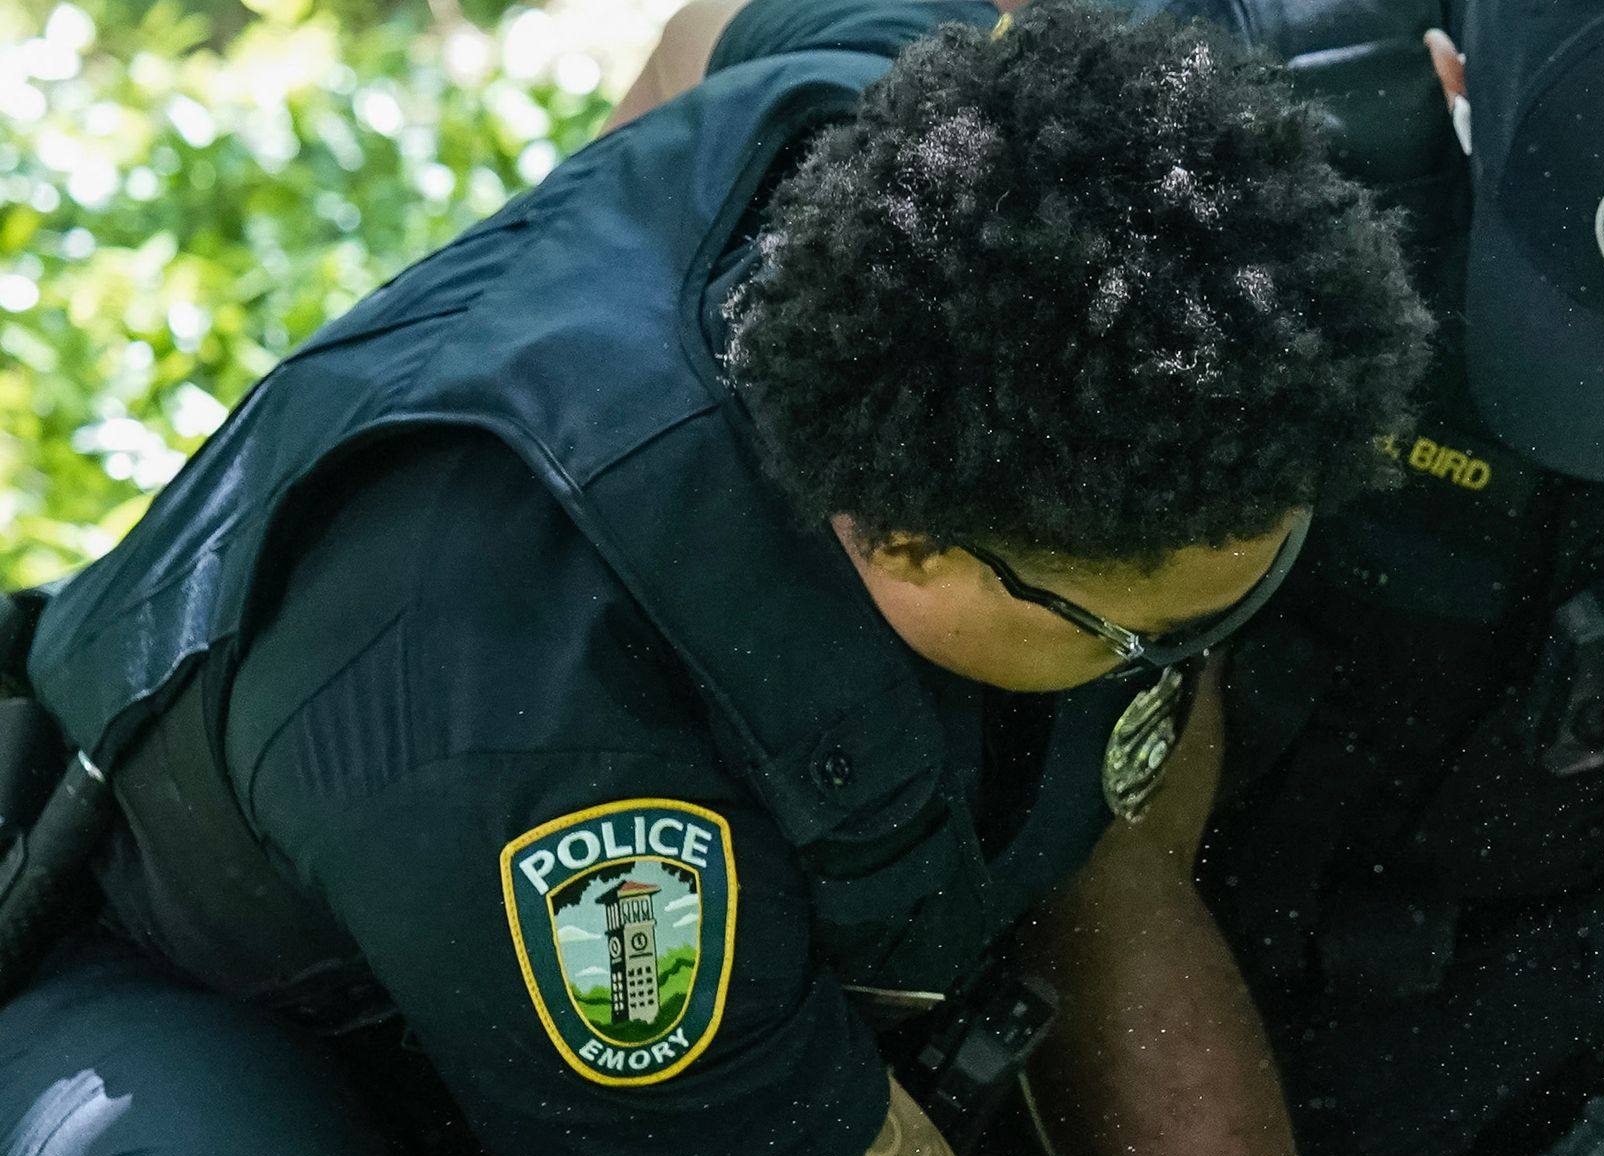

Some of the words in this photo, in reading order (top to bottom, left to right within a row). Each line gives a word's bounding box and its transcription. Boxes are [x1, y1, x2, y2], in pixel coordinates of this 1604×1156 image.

[1409, 437, 1492, 490] BIRD
[518, 816, 712, 896] POLICE
[579, 1027, 691, 1071] EMORY
